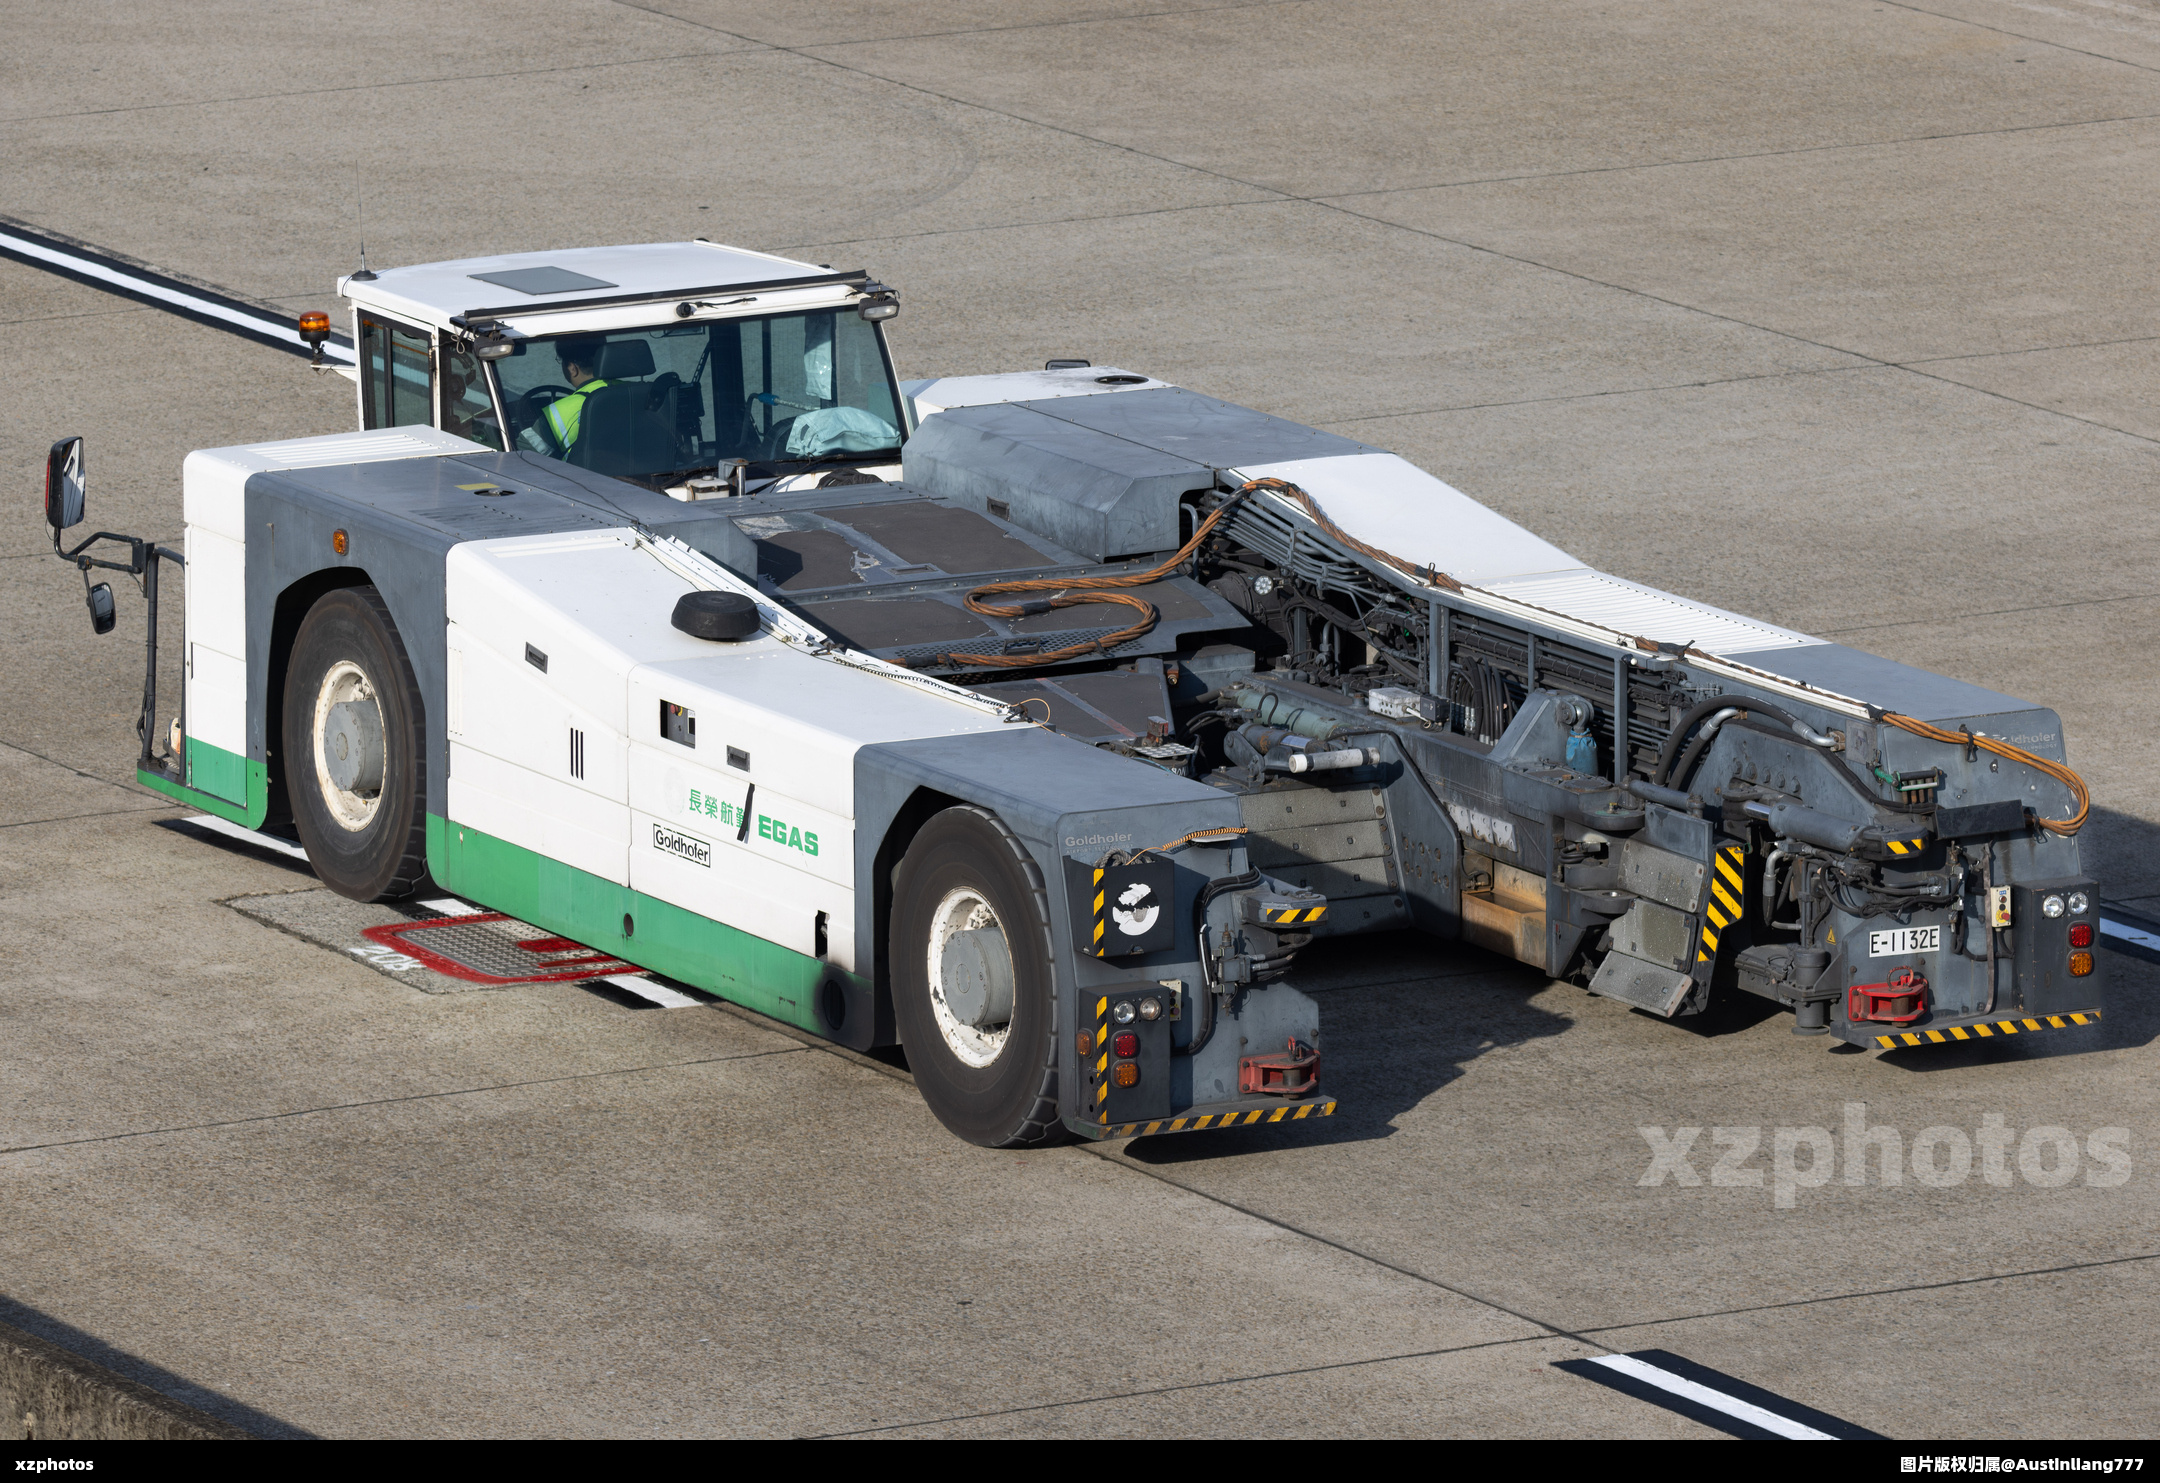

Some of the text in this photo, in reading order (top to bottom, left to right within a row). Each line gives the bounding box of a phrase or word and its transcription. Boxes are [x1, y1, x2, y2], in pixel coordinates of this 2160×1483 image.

[655, 829, 708, 862] Goldhofer
[758, 814, 818, 857] EGAS
[1065, 832, 1132, 847] Goldhofer
[1871, 928, 1938, 954] E-1132E
